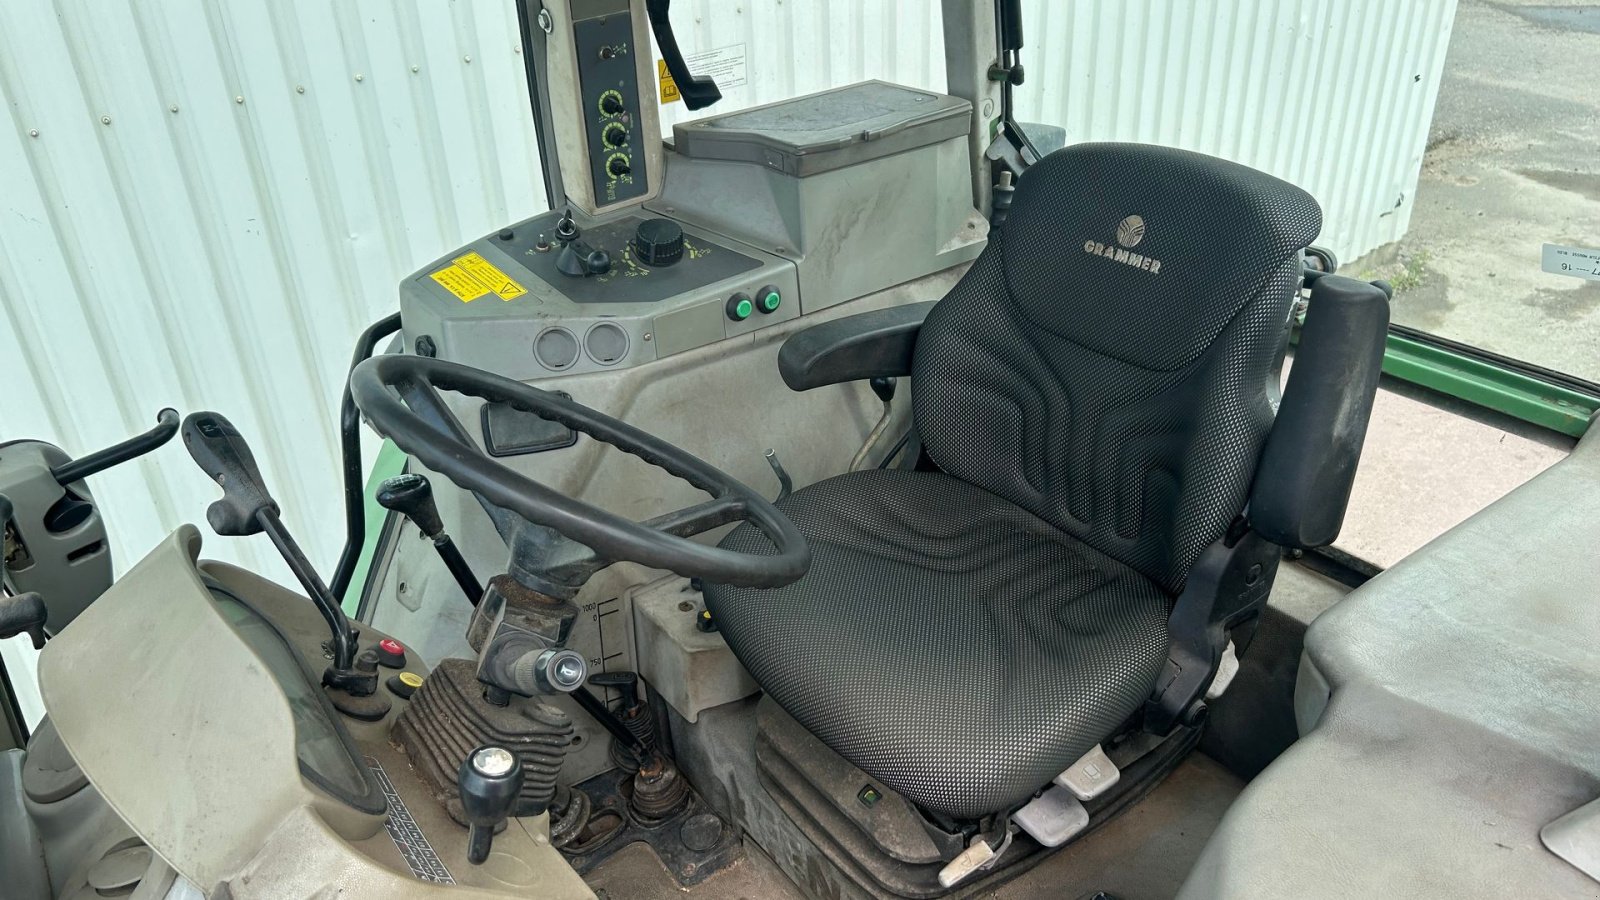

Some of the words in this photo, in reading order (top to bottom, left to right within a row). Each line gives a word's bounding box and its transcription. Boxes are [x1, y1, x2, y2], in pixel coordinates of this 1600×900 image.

[1084, 240, 1161, 274] GRAMMER
[1561, 263, 1572, 271] 16
[590, 658, 601, 668] 750
